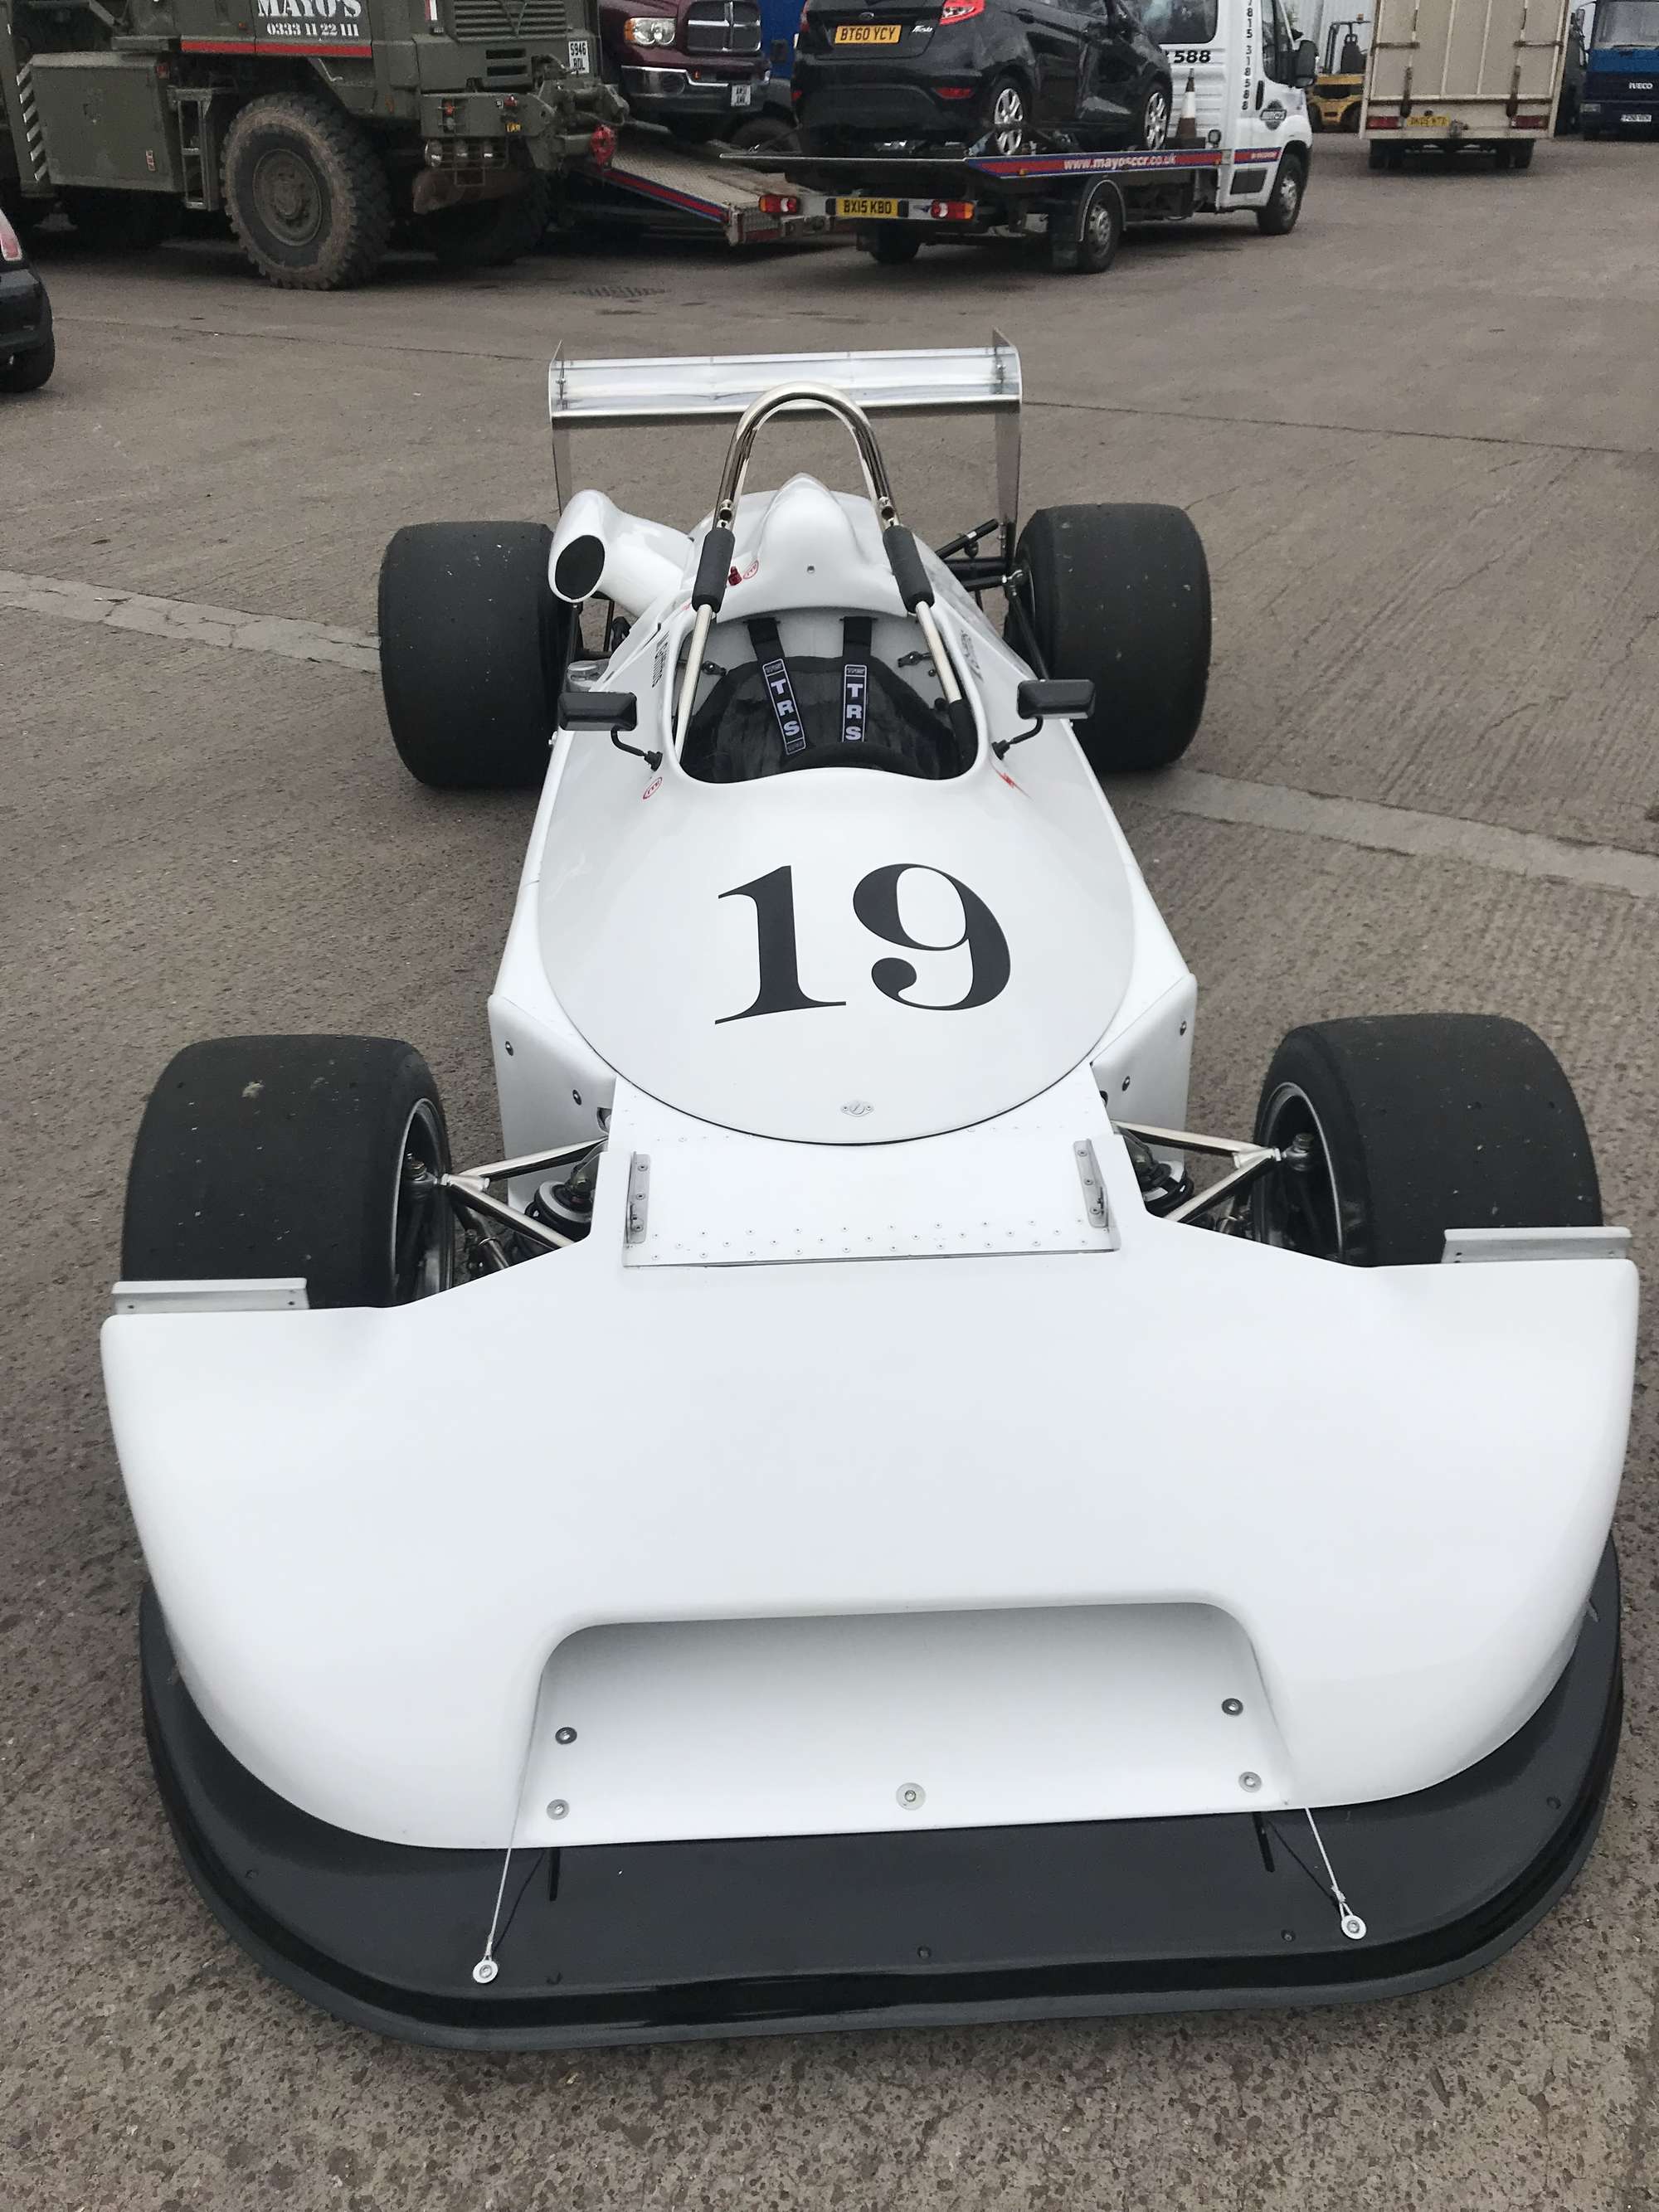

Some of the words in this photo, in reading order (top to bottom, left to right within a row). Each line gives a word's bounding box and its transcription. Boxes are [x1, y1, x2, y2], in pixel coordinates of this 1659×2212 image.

[257, 0, 362, 17] MAYOS
[266, 22, 301, 35] 0333
[304, 23, 317, 36] 11
[320, 23, 338, 36] 22
[339, 24, 359, 36] 111
[839, 27, 870, 41] BT60
[873, 27, 896, 41] YCY
[843, 200, 868, 213] BX15
[770, 678, 801, 737] TRS
[845, 683, 864, 741] TRS
[714, 863, 1012, 1025] 19
